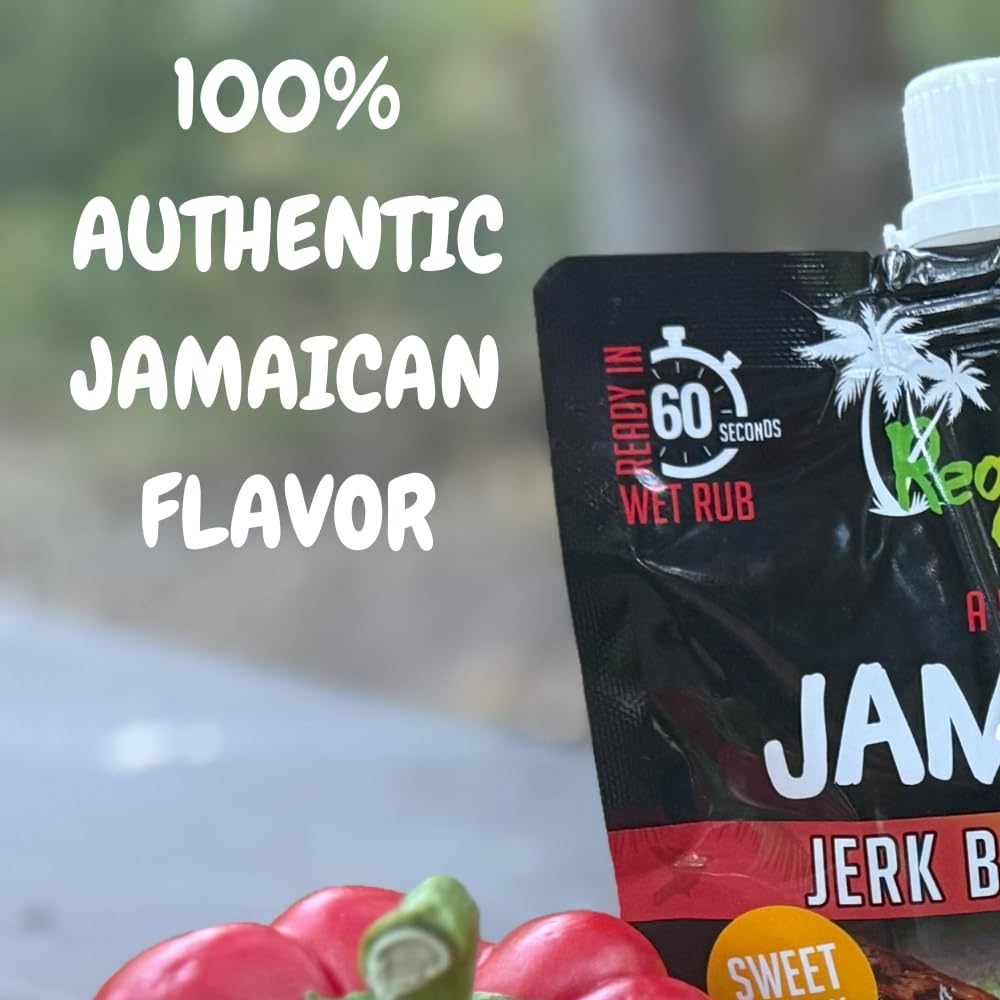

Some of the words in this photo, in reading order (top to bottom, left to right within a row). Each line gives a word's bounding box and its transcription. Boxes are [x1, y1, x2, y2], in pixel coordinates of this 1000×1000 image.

[603, 346, 644, 374] IN
[607, 385, 655, 476] READY
[650, 382, 713, 440] 60
[719, 418, 782, 442] SECONDS
[619, 483, 682, 526] WET
[692, 481, 755, 523] RUB
[807, 831, 943, 907] JERK
